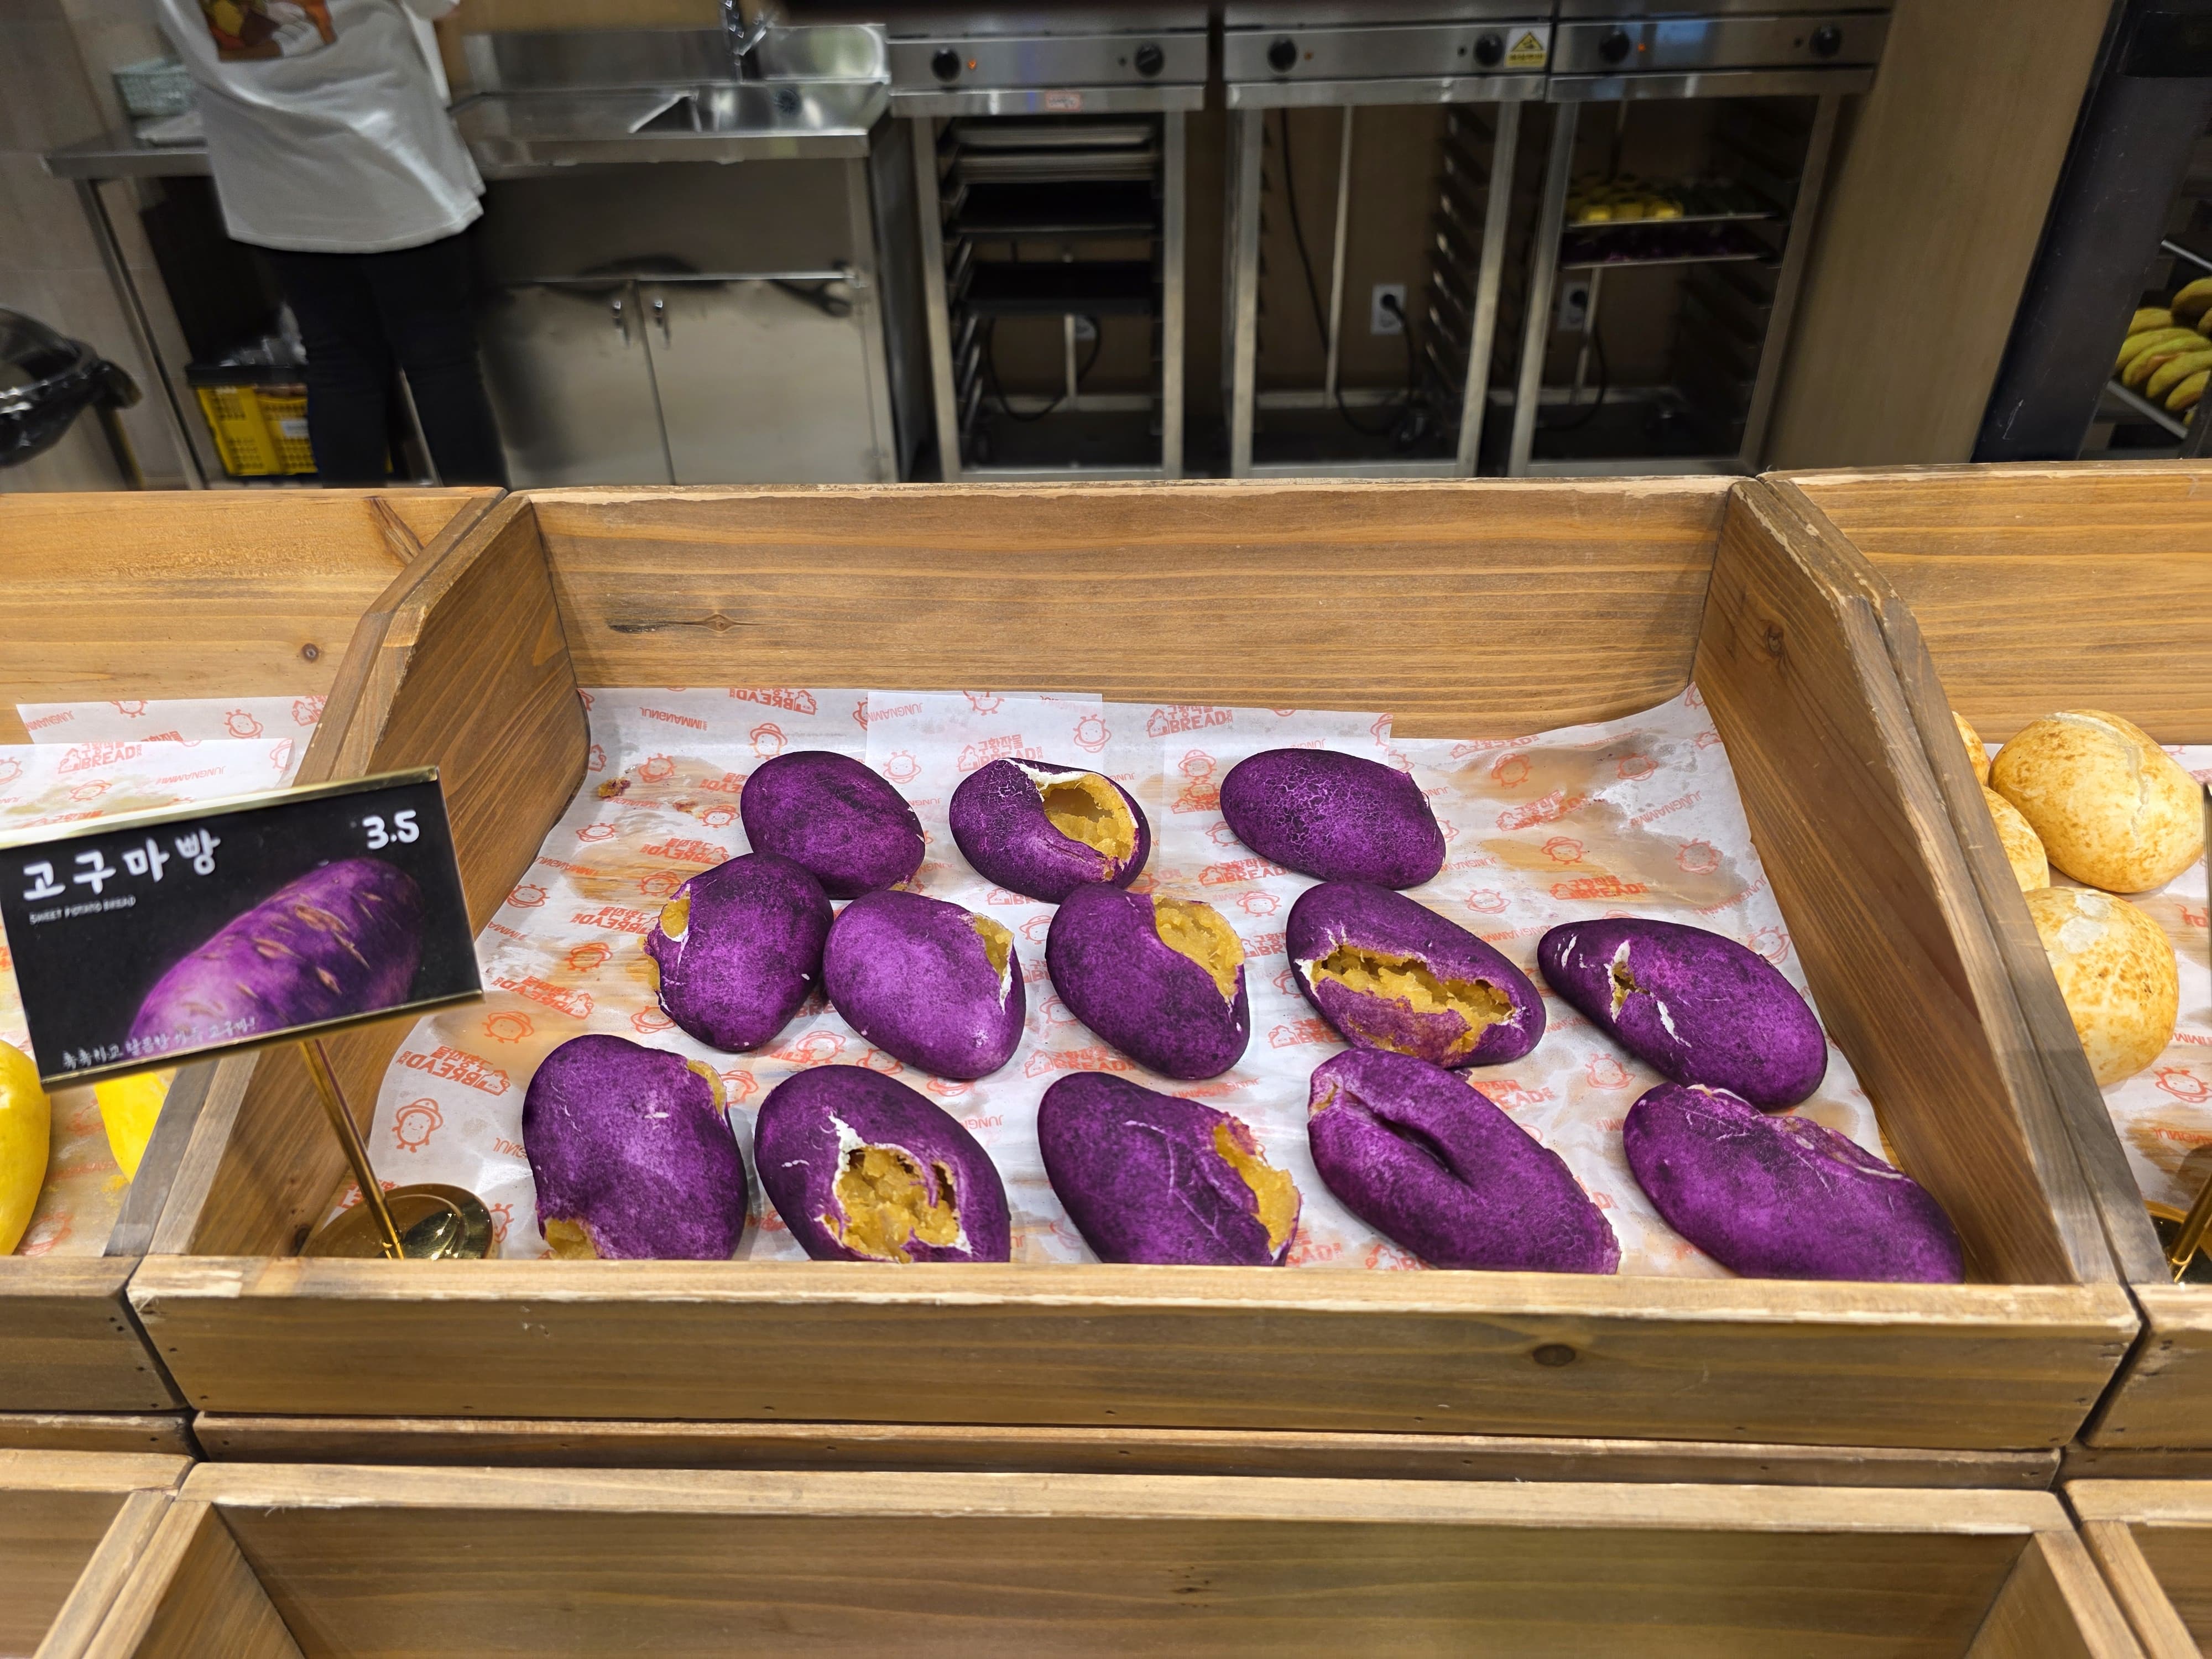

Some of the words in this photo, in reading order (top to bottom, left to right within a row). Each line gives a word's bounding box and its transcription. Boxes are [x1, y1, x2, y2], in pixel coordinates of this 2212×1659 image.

[1170, 711, 1226, 734] BREAD
[978, 734, 1024, 756] 구황작물
[82, 745, 136, 769] BREAD
[362, 810, 420, 849] 3.5
[23, 828, 221, 901] 고구마빵
[1580, 883, 1640, 899] BREAD
[1053, 1057, 1126, 1071] BREAD
